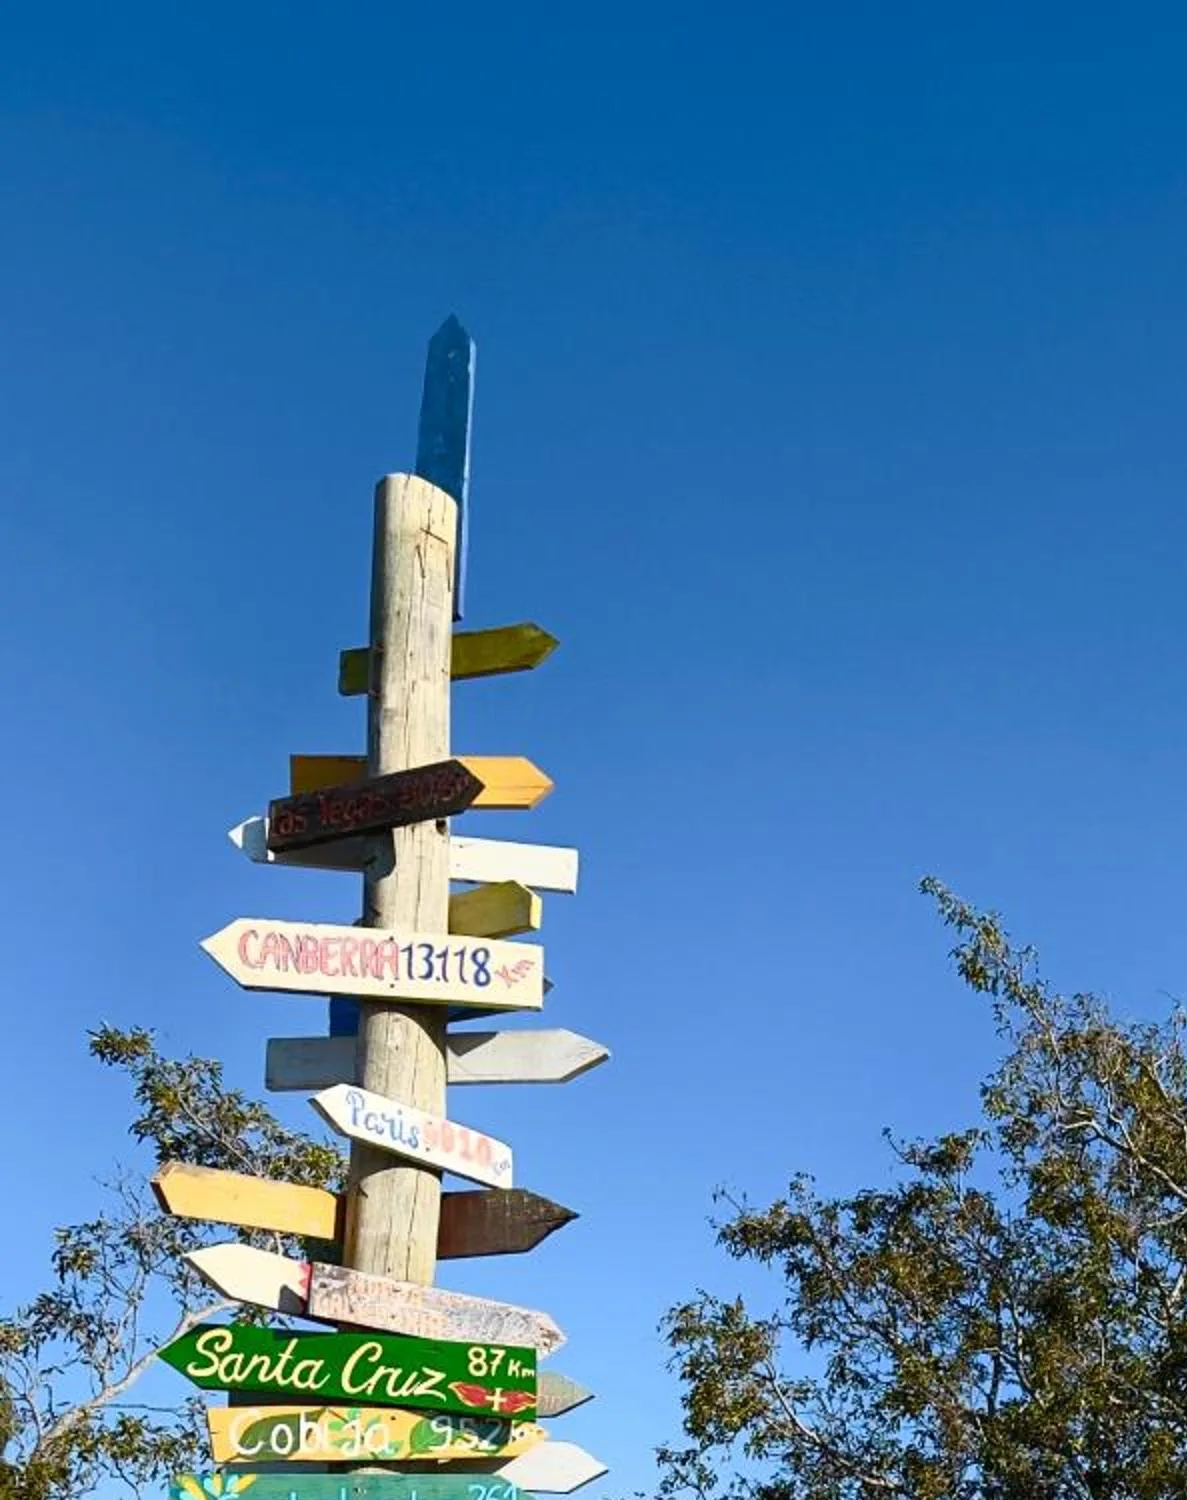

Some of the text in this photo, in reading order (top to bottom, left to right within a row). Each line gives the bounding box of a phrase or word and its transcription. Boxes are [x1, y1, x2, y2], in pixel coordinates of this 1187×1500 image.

[237, 929, 400, 981] CANBERRA
[400, 942, 491, 988] 13.118
[345, 1089, 421, 1150] Paris
[187, 1328, 447, 1402] Santa Cruz
[467, 1348, 504, 1378] 87
[228, 1407, 500, 1456] Cobija 952
